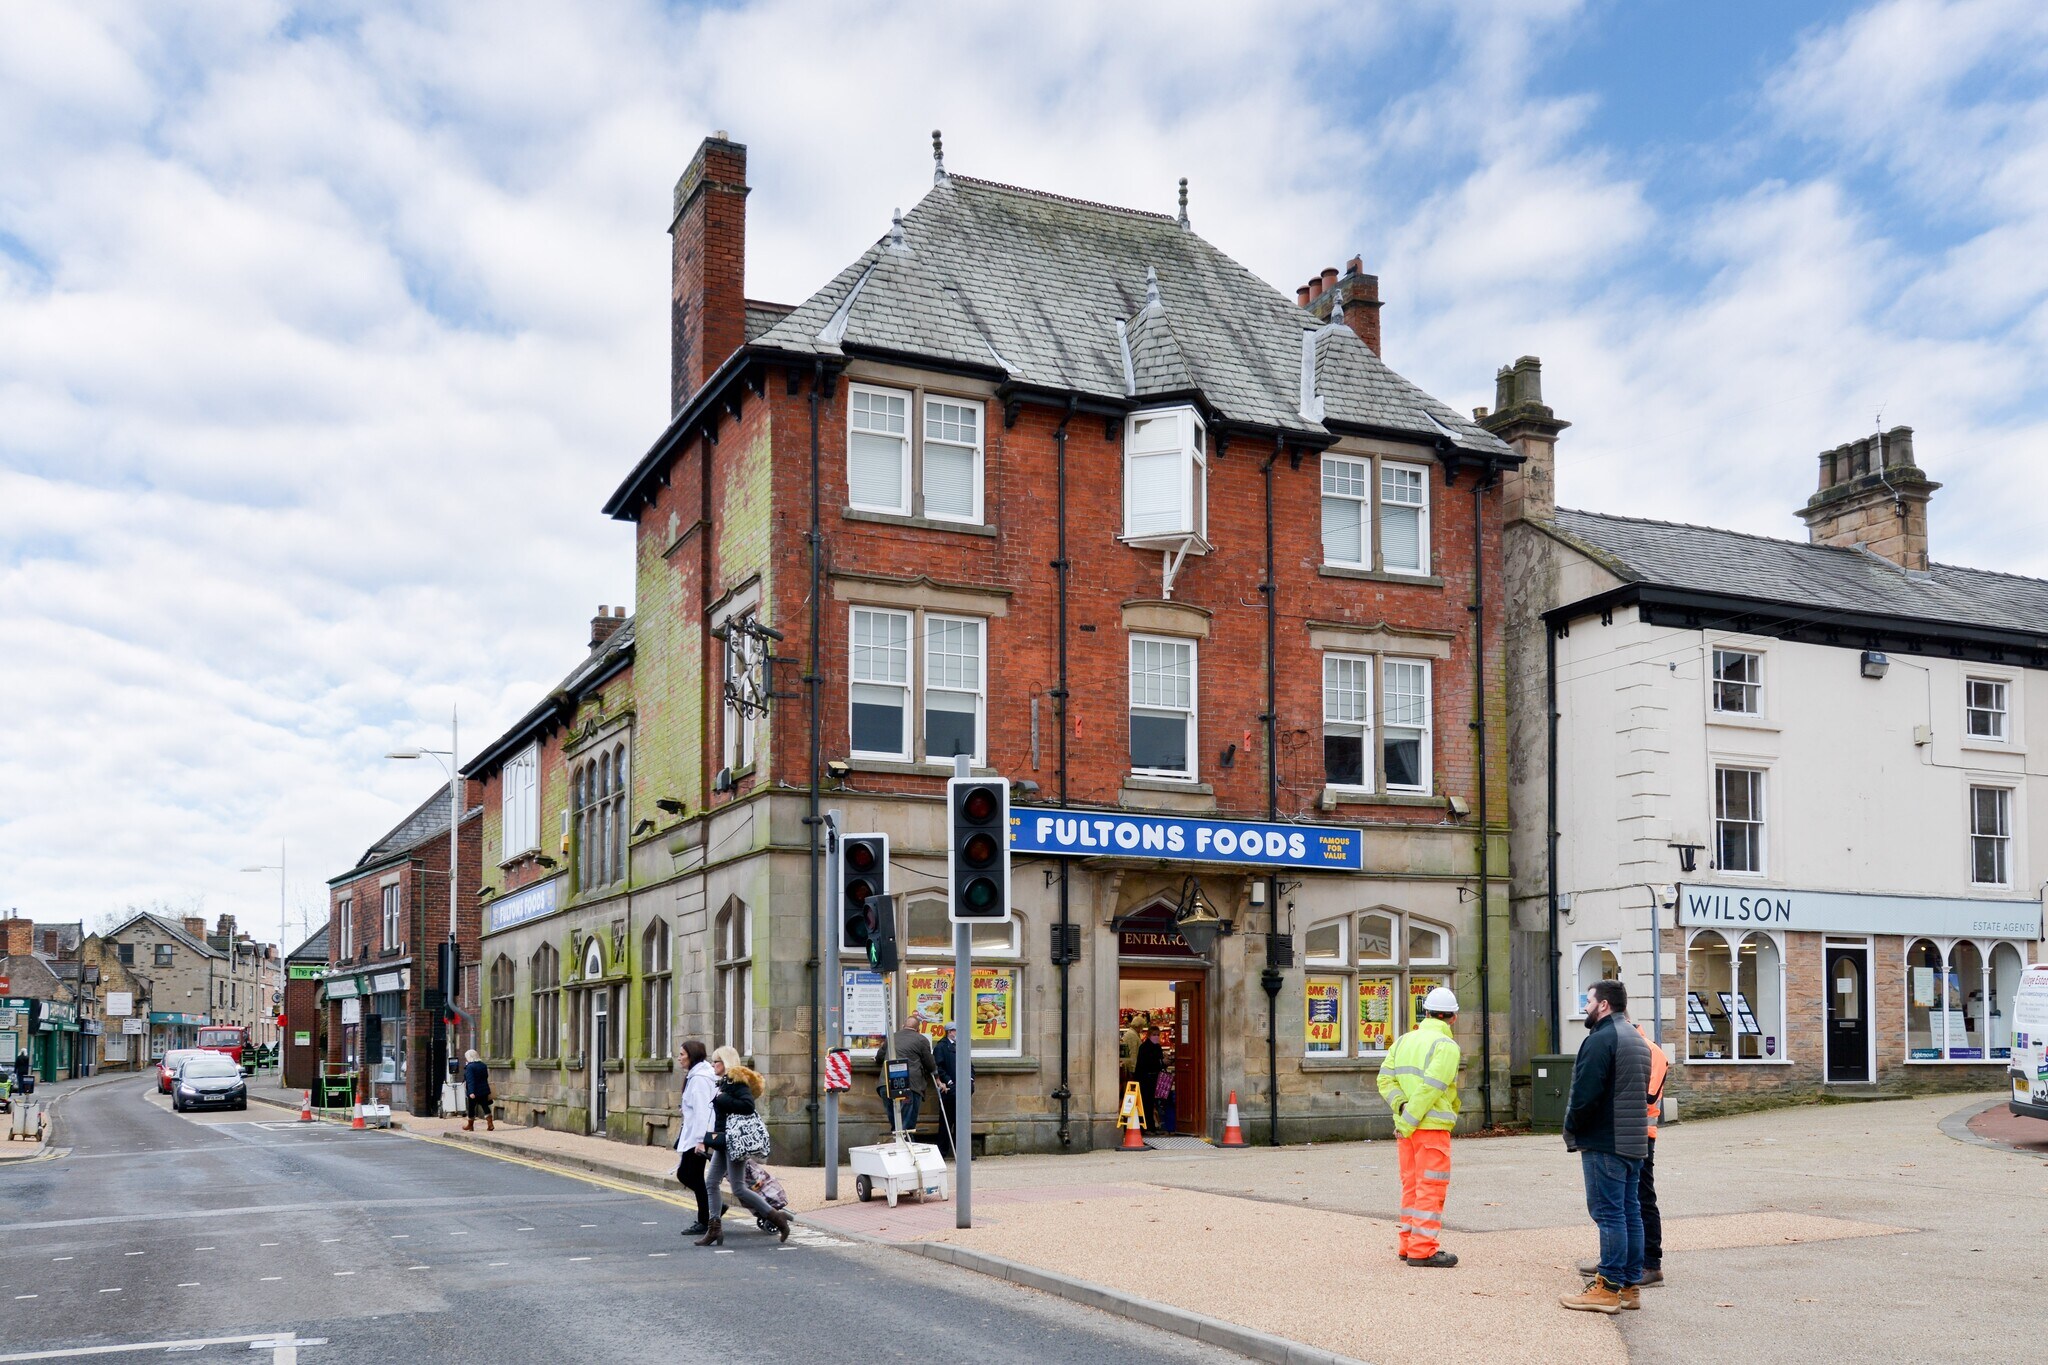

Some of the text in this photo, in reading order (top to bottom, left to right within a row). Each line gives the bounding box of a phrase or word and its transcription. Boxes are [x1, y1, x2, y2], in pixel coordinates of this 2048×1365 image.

[1036, 817, 1185, 852] FULTONS
[1196, 827, 1306, 859] FOODS
[1319, 836, 1350, 845] FAMOUS
[1327, 844, 1342, 852] FOR
[1323, 851, 1347, 860] VALUE
[500, 898, 524, 924] FULTONS
[524, 890, 545, 915] FOODS
[1689, 894, 1791, 922] WILSON
[1973, 921, 2035, 932] ESTATE AGENTS
[1125, 933, 1189, 946] ENTRANC
[294, 968, 308, 977] The
[912, 978, 933, 989] SAVE
[973, 977, 993, 989] SAVE
[1307, 985, 1325, 996] SAVE
[1359, 985, 1376, 996] SAVE
[1410, 984, 1426, 995] SAVE
[983, 1018, 997, 1036] £1
[1311, 1023, 1320, 1039] 4
[1363, 1023, 1373, 1038] 4
